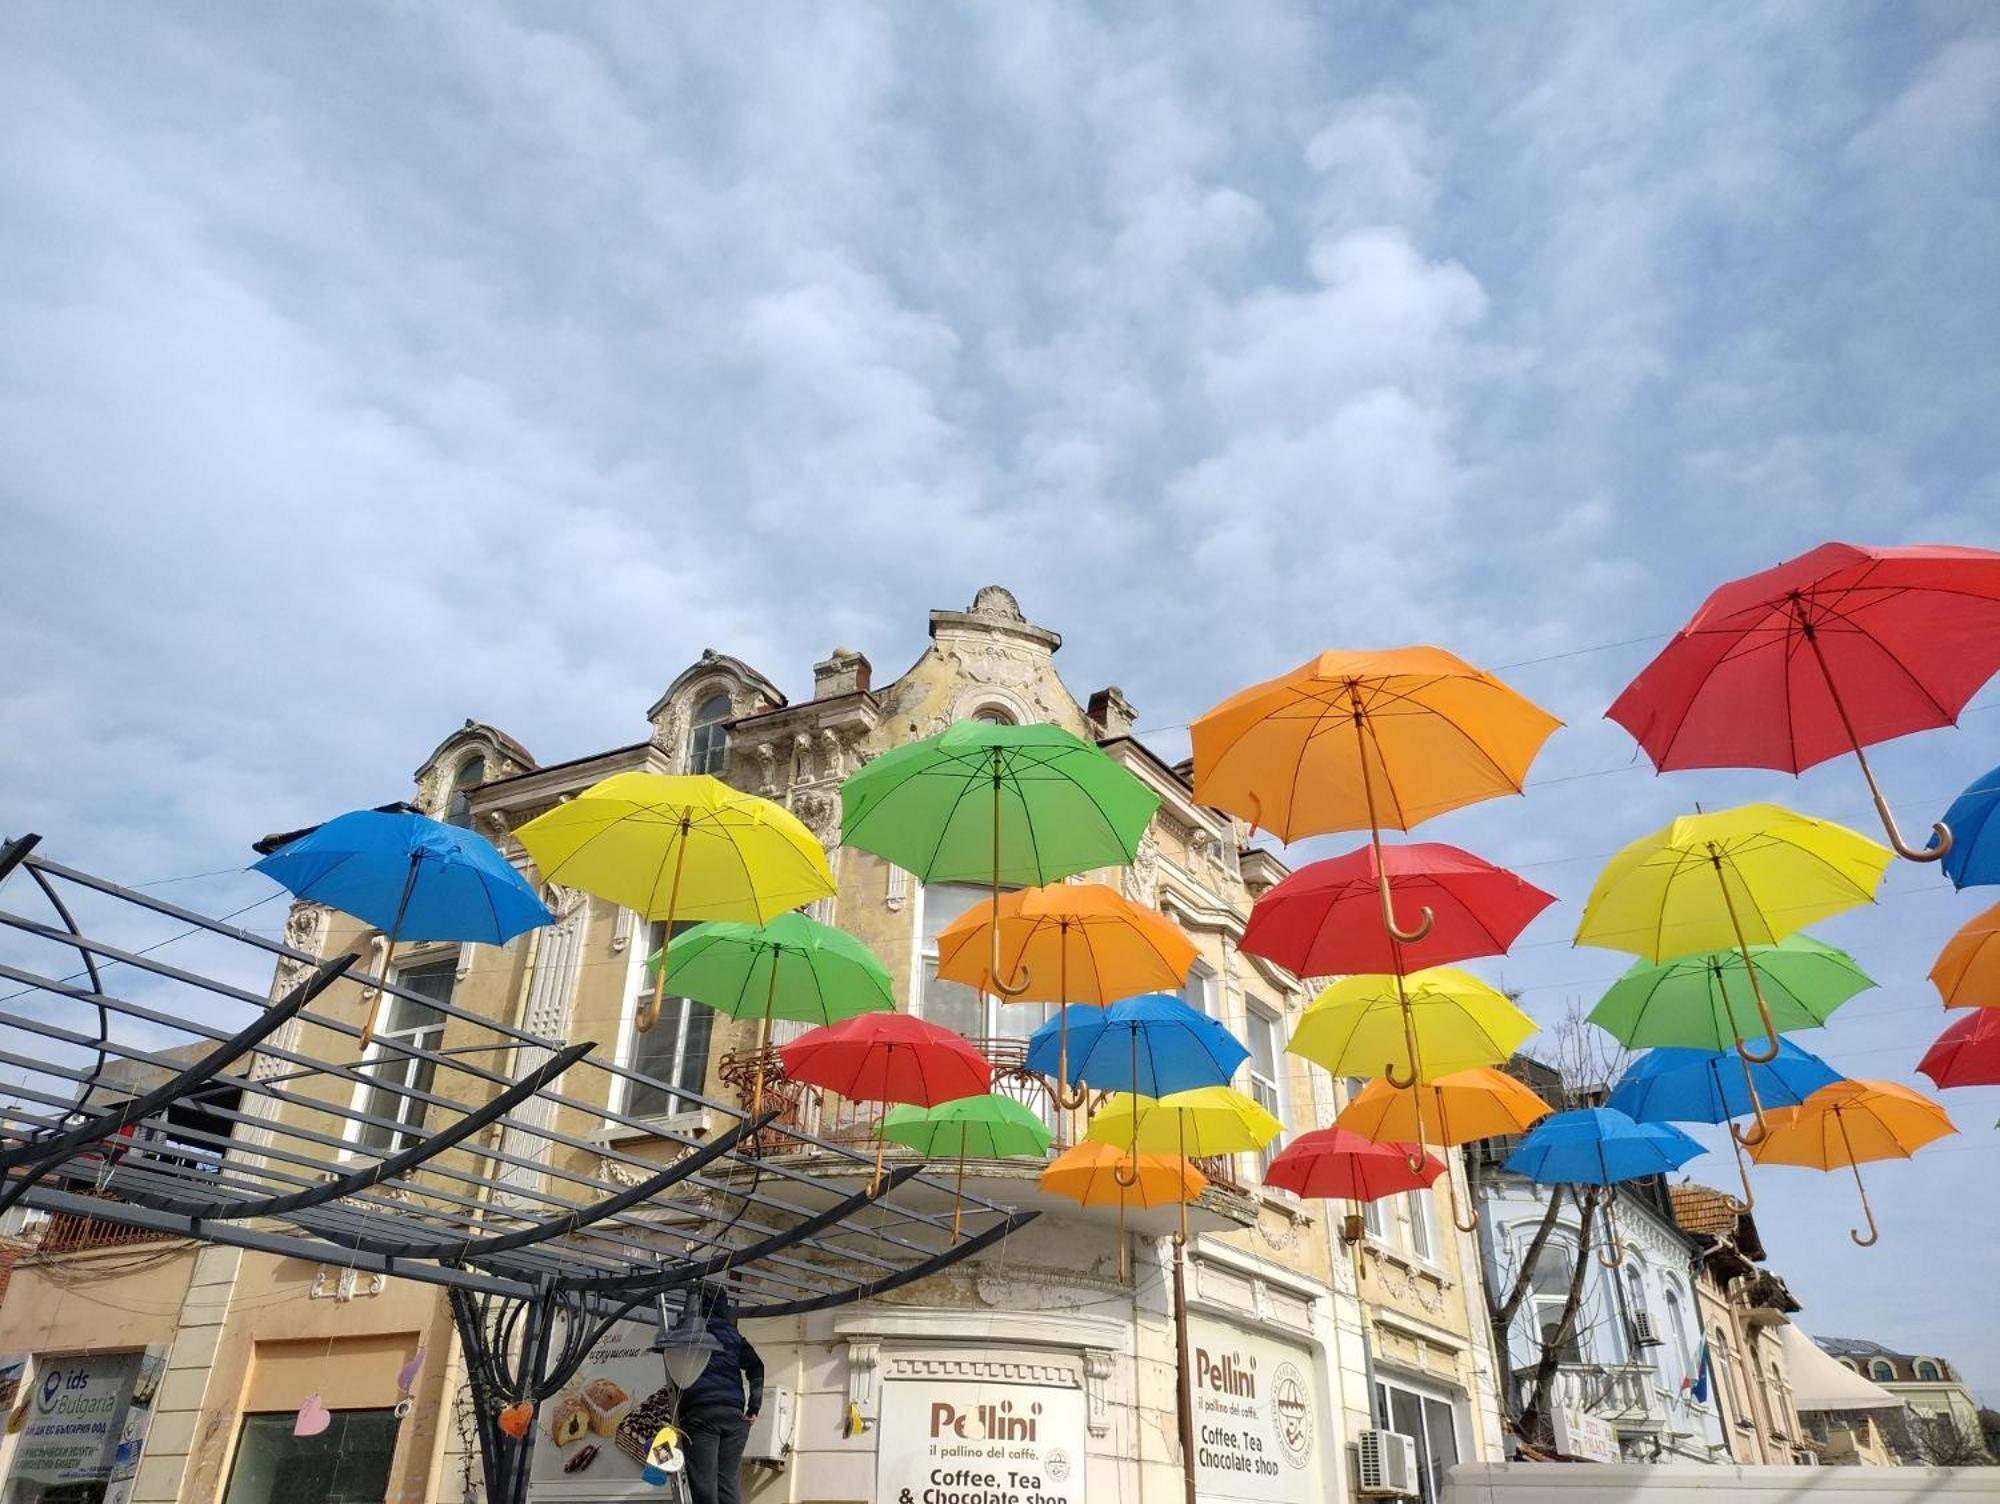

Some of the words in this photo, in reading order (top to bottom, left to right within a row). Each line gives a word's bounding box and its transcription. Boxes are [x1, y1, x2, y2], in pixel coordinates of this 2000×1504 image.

[65, 1368, 89, 1390] ids
[1195, 1347, 1257, 1399] Pellini
[57, 1393, 115, 1420] Bulgaria
[1229, 1402, 1241, 1417] del
[930, 1445, 937, 1456] il
[941, 1445, 983, 1459] pallino
[986, 1446, 1005, 1459] del
[1242, 1431, 1262, 1452] Tea
[1199, 1447, 1252, 1473] Chocolate
[1255, 1456, 1279, 1476] shop
[930, 1468, 1001, 1488] Coffee,
[1007, 1471, 1041, 1489] Tea
[899, 1487, 914, 1504] &
[923, 1488, 1019, 1504] Chocolate
